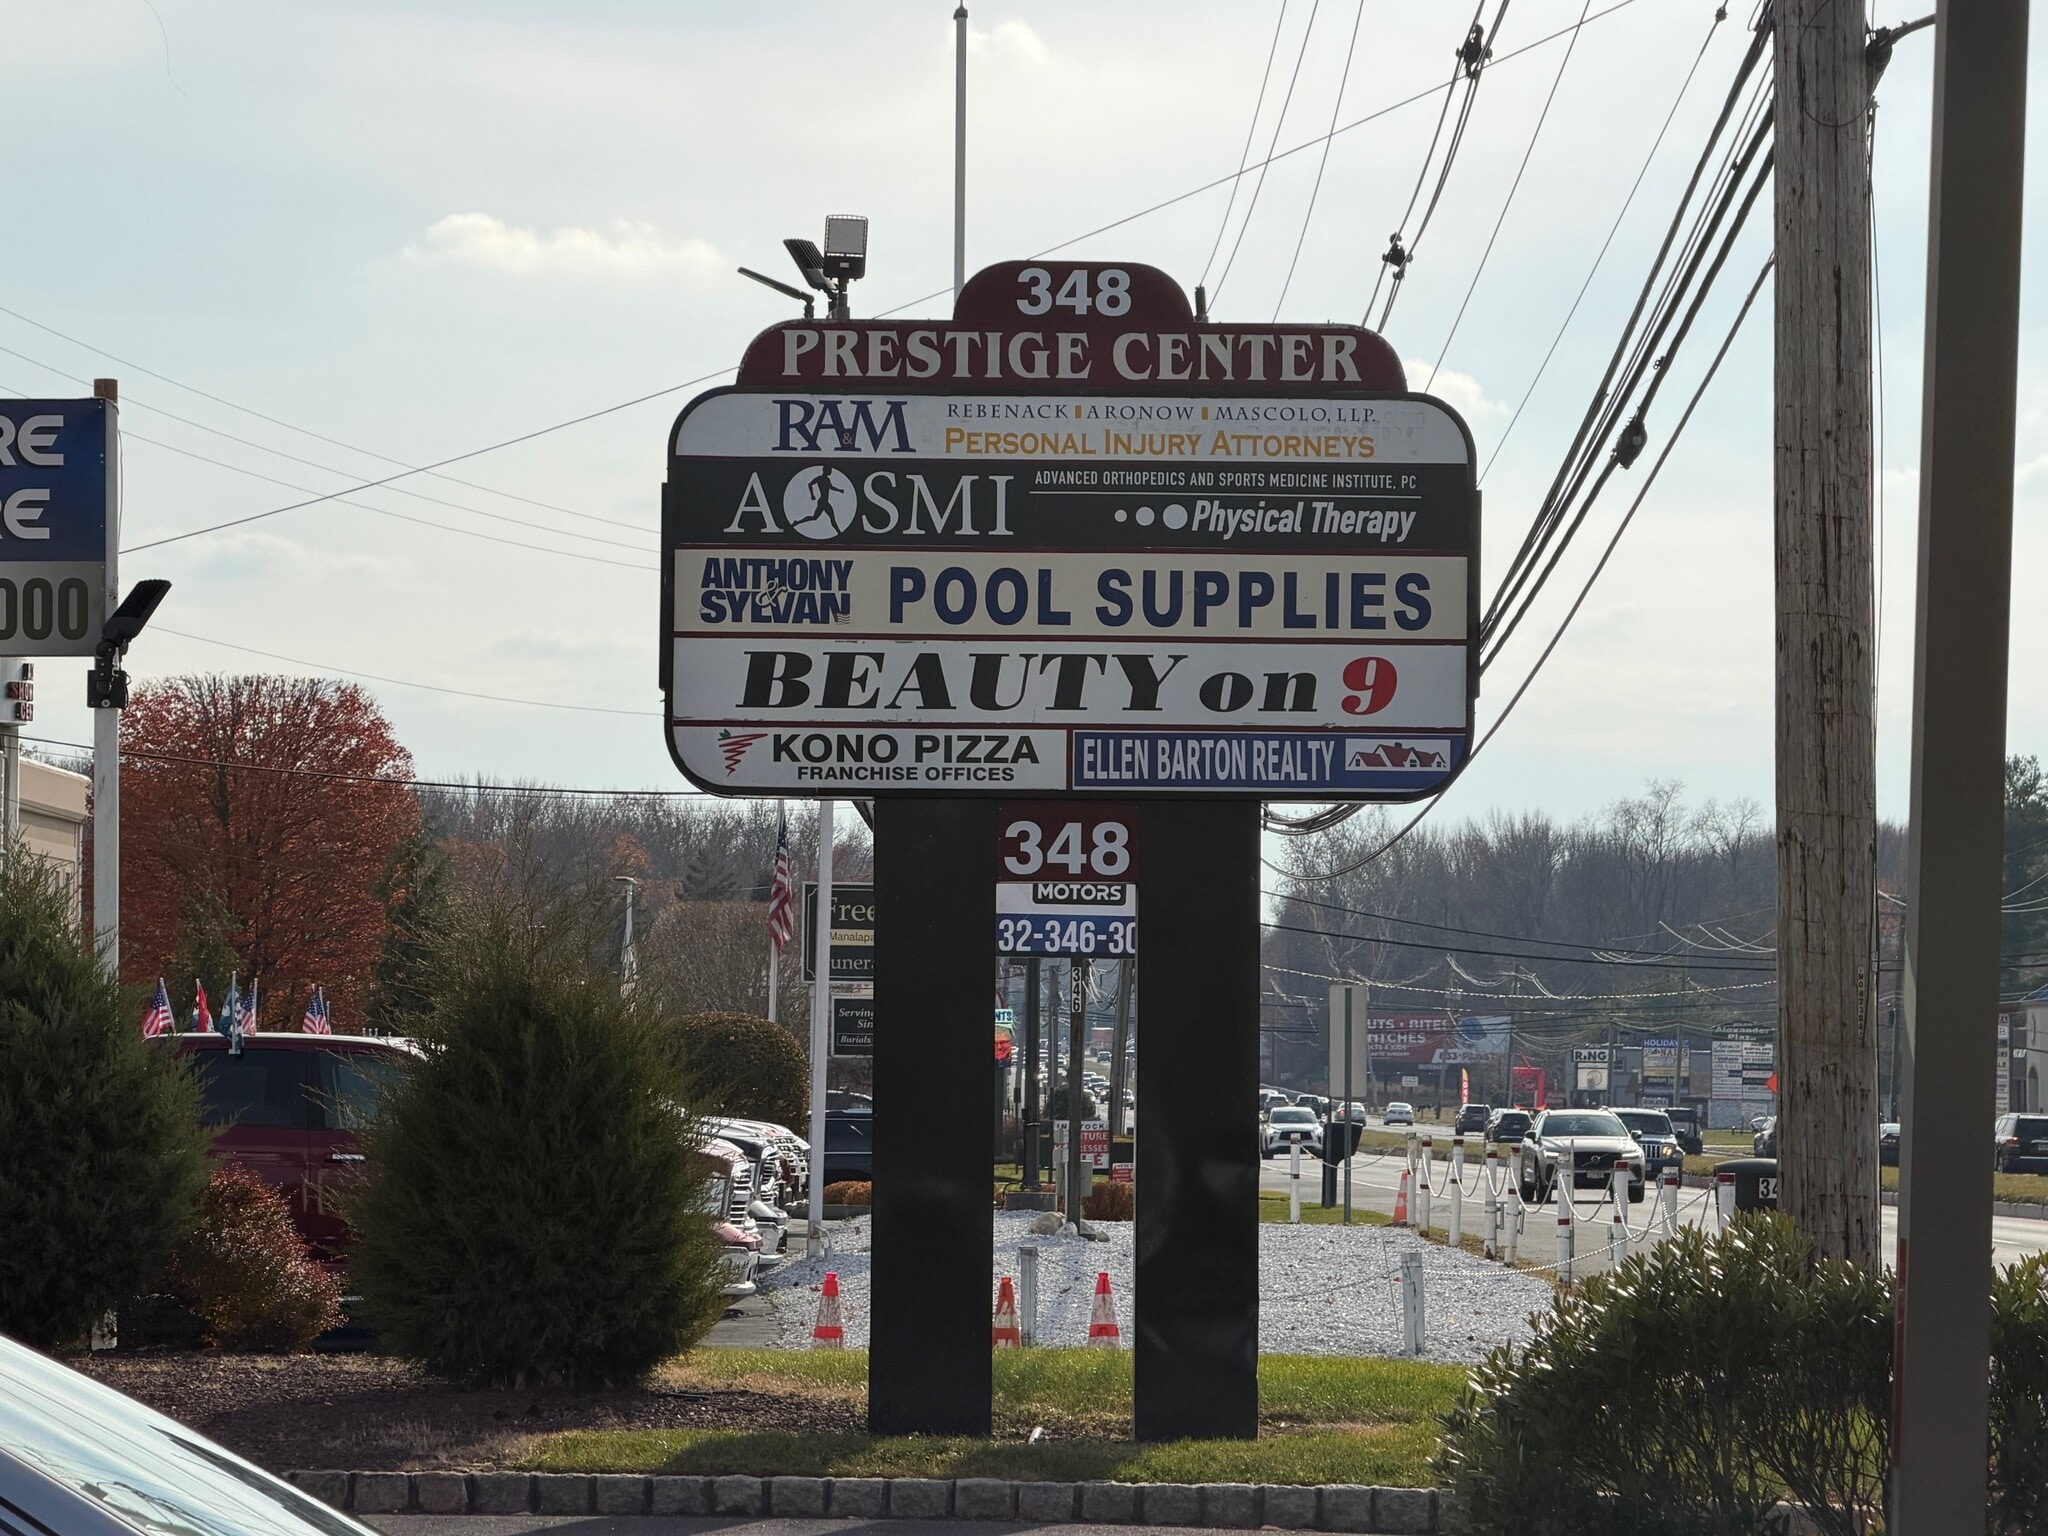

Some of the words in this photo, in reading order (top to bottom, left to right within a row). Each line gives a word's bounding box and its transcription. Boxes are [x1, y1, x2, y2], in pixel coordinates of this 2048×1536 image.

[1016, 268, 1132, 316] 348
[781, 329, 1092, 380] PRESTIGE
[1112, 332, 1362, 382] CENTER
[947, 404, 1069, 419] REBENACK
[1086, 405, 1195, 420] ARONOW
[1104, 429, 1202, 456] INJURY
[1209, 430, 1375, 458] ATTORNEYS
[1035, 470, 1098, 486] ADVANCED
[1102, 471, 1186, 487] ORTHOPEDICS
[1190, 472, 1214, 486] AND
[1218, 473, 1265, 488] SPORTS
[1270, 474, 1328, 488] MEDICINE
[1332, 474, 1397, 491] INSTITUTE,
[1402, 476, 1417, 490] PC
[1191, 500, 1302, 541] Physical
[1310, 502, 1416, 542] Therapy
[701, 557, 854, 592] ANTHONY
[700, 589, 851, 625] SYLVAN
[889, 566, 1072, 626] POOL
[1095, 568, 1432, 631] SUPPLIES
[735, 651, 1188, 711] BEAUTY
[1200, 672, 1318, 712] on
[1340, 656, 1398, 716] 9
[772, 734, 899, 764] KONO
[914, 735, 1040, 764] PIZZA
[1083, 738, 1149, 780] ELLEN
[1157, 739, 1247, 780] BARTON
[1254, 740, 1336, 782] REALTY
[797, 766, 918, 780] FRANCHISE
[924, 767, 1015, 782] OFFICES
[1004, 820, 1130, 876] 348
[1038, 884, 1122, 900] MOTORS
[831, 958, 874, 970] uner
[840, 1035, 871, 1044] Burials
